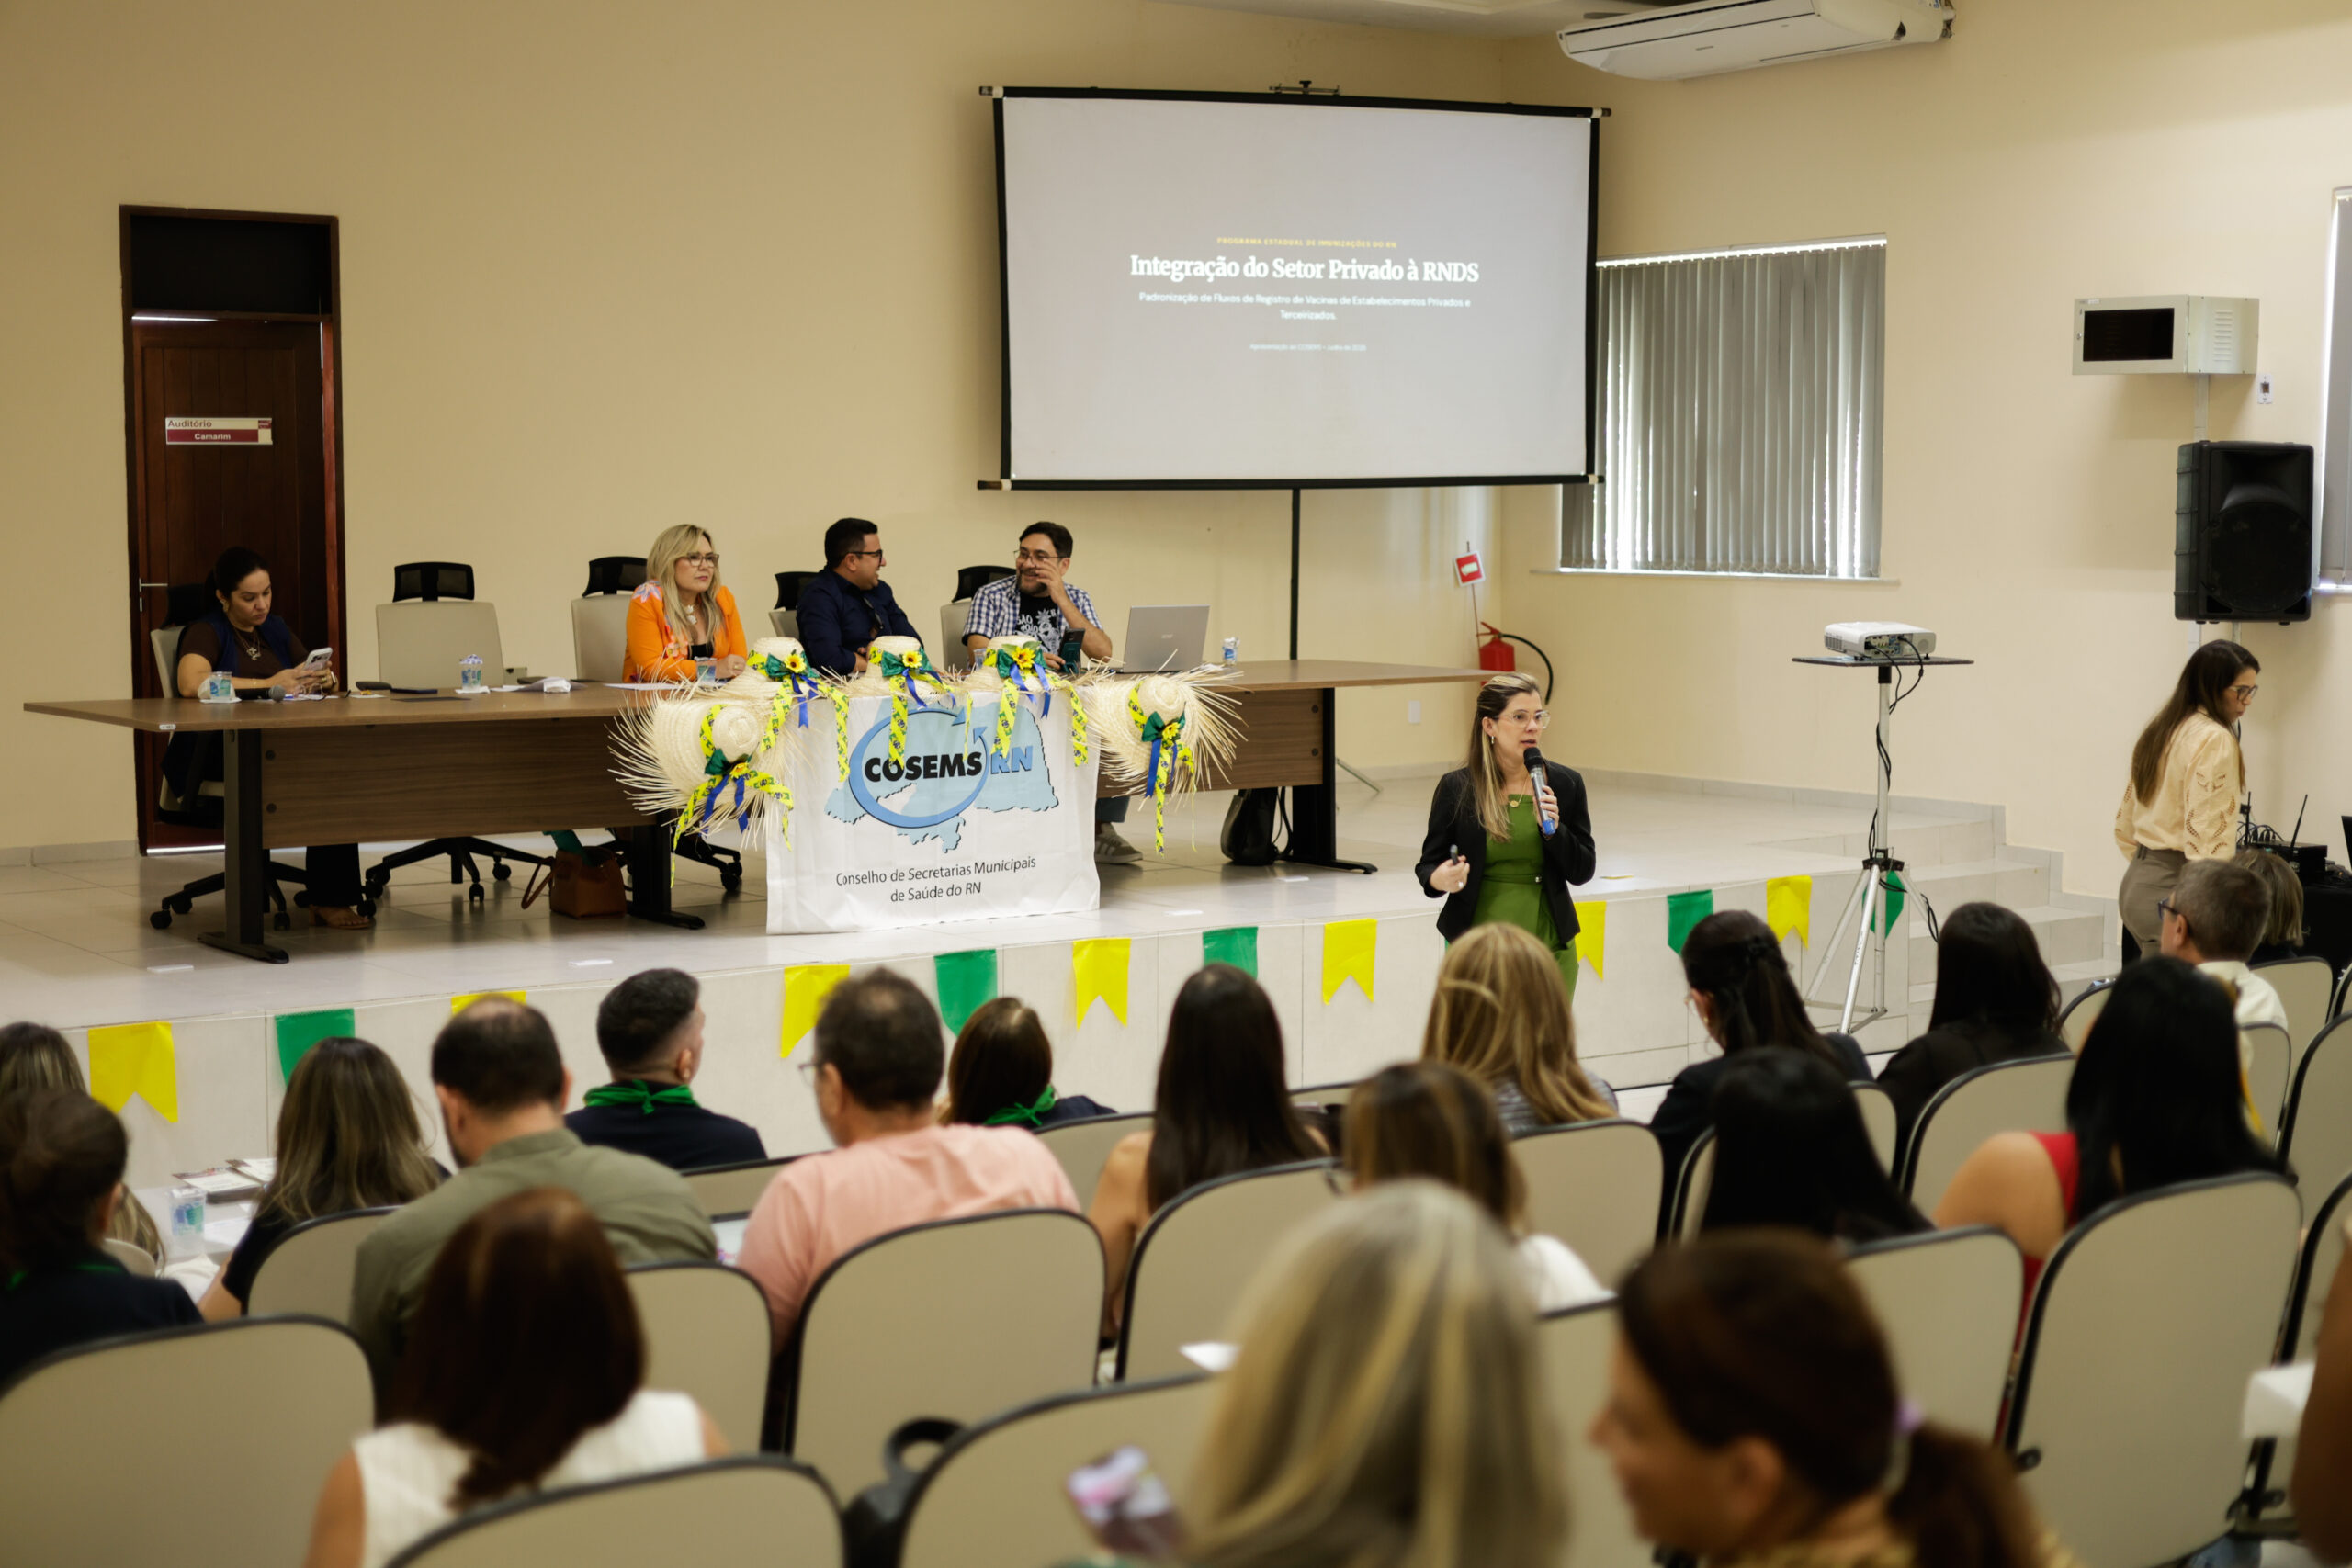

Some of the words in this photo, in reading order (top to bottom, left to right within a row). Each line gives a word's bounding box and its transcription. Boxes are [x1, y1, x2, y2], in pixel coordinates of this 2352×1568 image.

[1263, 238, 1303, 246] ESTADUAL
[1130, 254, 1240, 282] Integração
[1243, 255, 1269, 277] do
[1272, 258, 1325, 279] Setor
[1329, 258, 1404, 280] Privado
[1407, 258, 1419, 281] à
[1423, 261, 1479, 282] RNDS
[1139, 292, 1198, 304] Padronização
[1200, 293, 1212, 302] de
[1214, 293, 1240, 303] Fluxos
[1242, 294, 1254, 303] de
[1256, 294, 1291, 306] Registro
[1292, 295, 1304, 304] de
[1305, 295, 1338, 305] Vacinas
[1340, 296, 1351, 305] de
[1352, 296, 1426, 307] Estabelecimentos
[1427, 297, 1464, 307] Privados
[1280, 310, 1337, 320] Terceirizados.
[168, 420, 212, 428] Auditório
[865, 752, 982, 782] COSEMS
[990, 745, 1033, 774] RN
[836, 871, 887, 886] Conselho
[890, 868, 905, 882] de
[908, 864, 971, 881] Secretarias
[974, 856, 1036, 874] Municipais
[890, 888, 905, 902] de
[908, 886, 943, 901] Saúde
[946, 884, 962, 897] do
[966, 881, 981, 895] RN
